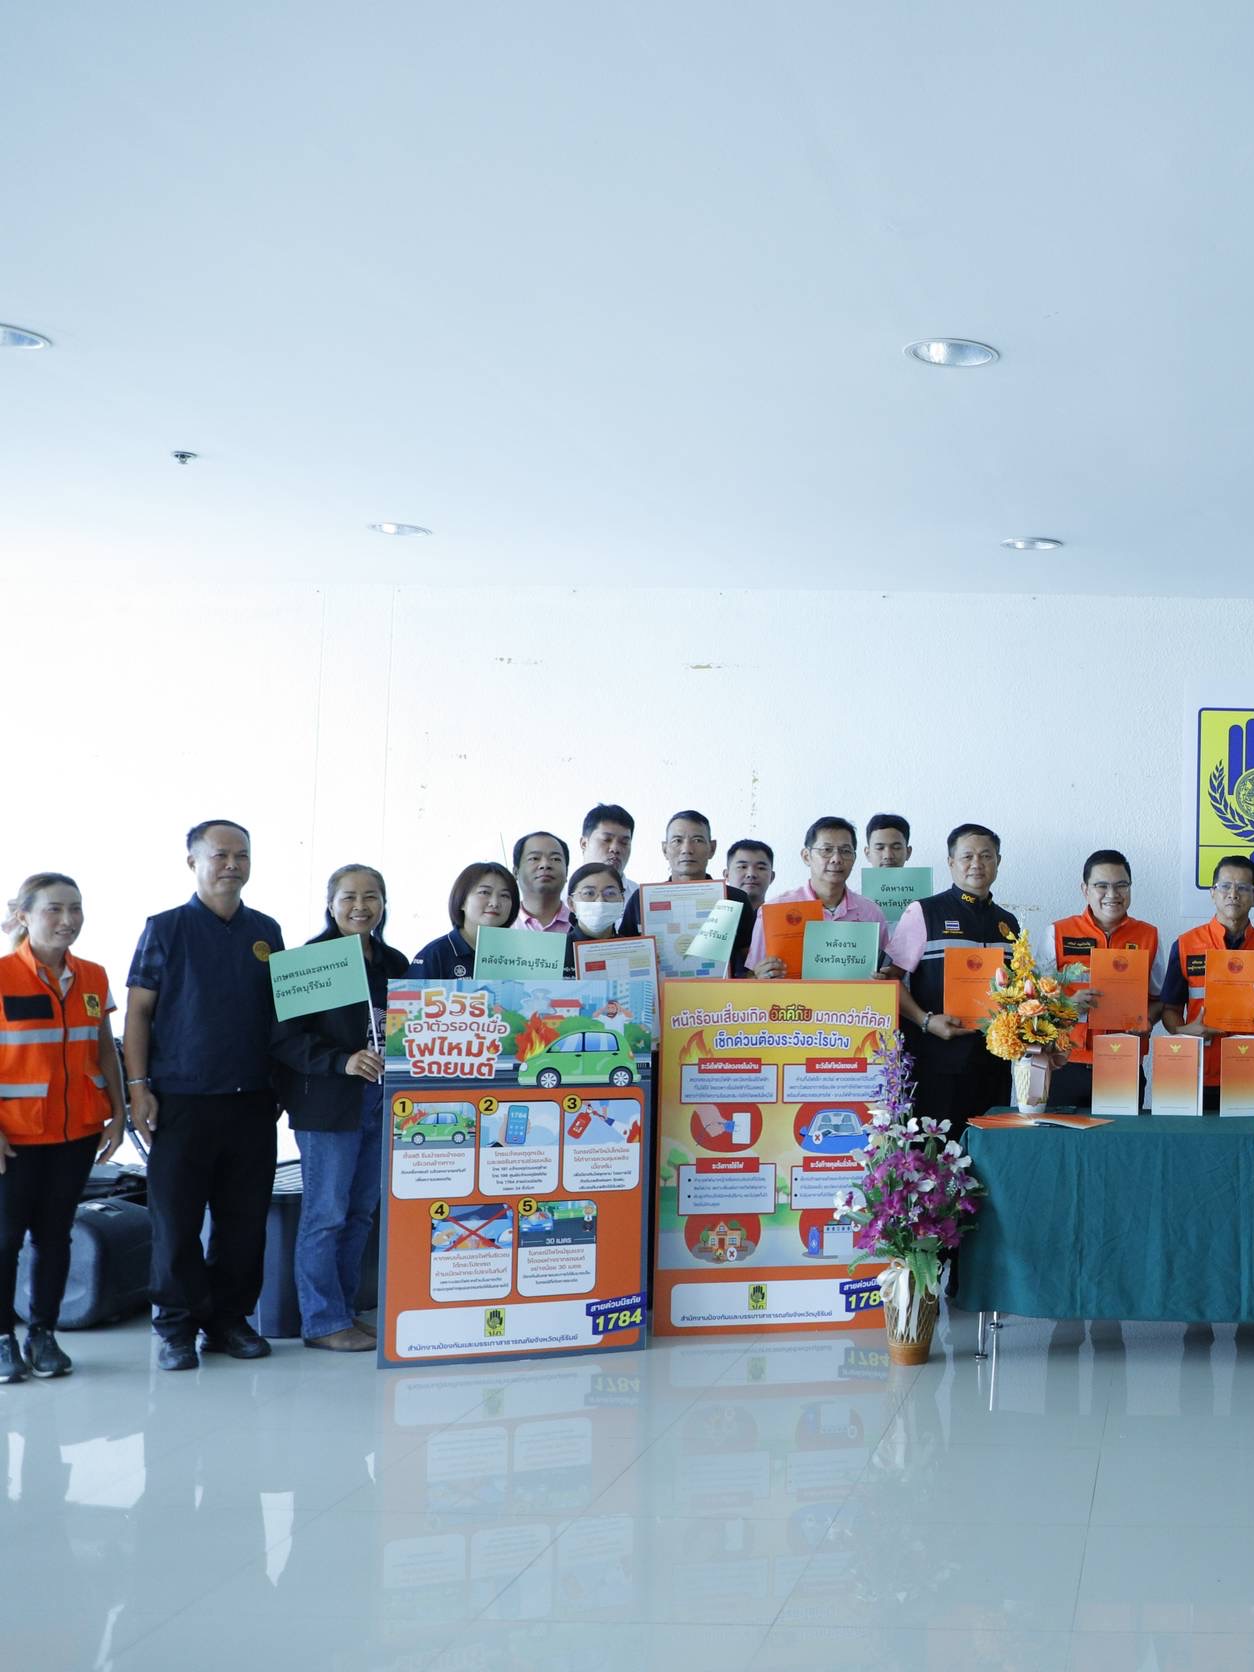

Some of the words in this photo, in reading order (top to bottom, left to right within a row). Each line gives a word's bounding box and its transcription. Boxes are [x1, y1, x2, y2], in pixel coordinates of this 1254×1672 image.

[881, 885, 914, 893] จัดหางาน
[825, 938, 857, 949] พลังงาน
[481, 955, 559, 970] คลังจังหวัดบุรีรัมย์
[814, 954, 867, 966] จังหวัดบุรีรัมย์
[273, 958, 349, 983] เกษตรและสหกรณ์
[275, 978, 333, 999] จังหวัดบุรีรัมย์
[671, 1003, 767, 1028] หน้าร้อนเสี่ยงเกิด
[769, 1004, 812, 1023] อัคคีภัย
[815, 1006, 891, 1028] มากกว่าที่คิด!
[407, 1015, 509, 1036] เอาตัวรอดเมื่อ
[405, 1032, 486, 1060] ไฟไหม้
[714, 1031, 850, 1050] เช็กด่วนต้องระวังอะไรบ้าง
[411, 1056, 497, 1079] รถยนต์
[399, 1101, 407, 1113] 1
[484, 1100, 494, 1112] 2
[567, 1098, 578, 1110] 3
[434, 1203, 445, 1216] 4
[523, 1200, 533, 1212] 5
[590, 1295, 642, 1313] สายด่วนนิรภัย
[849, 1291, 882, 1310] 178
[596, 1307, 643, 1332] 1784
